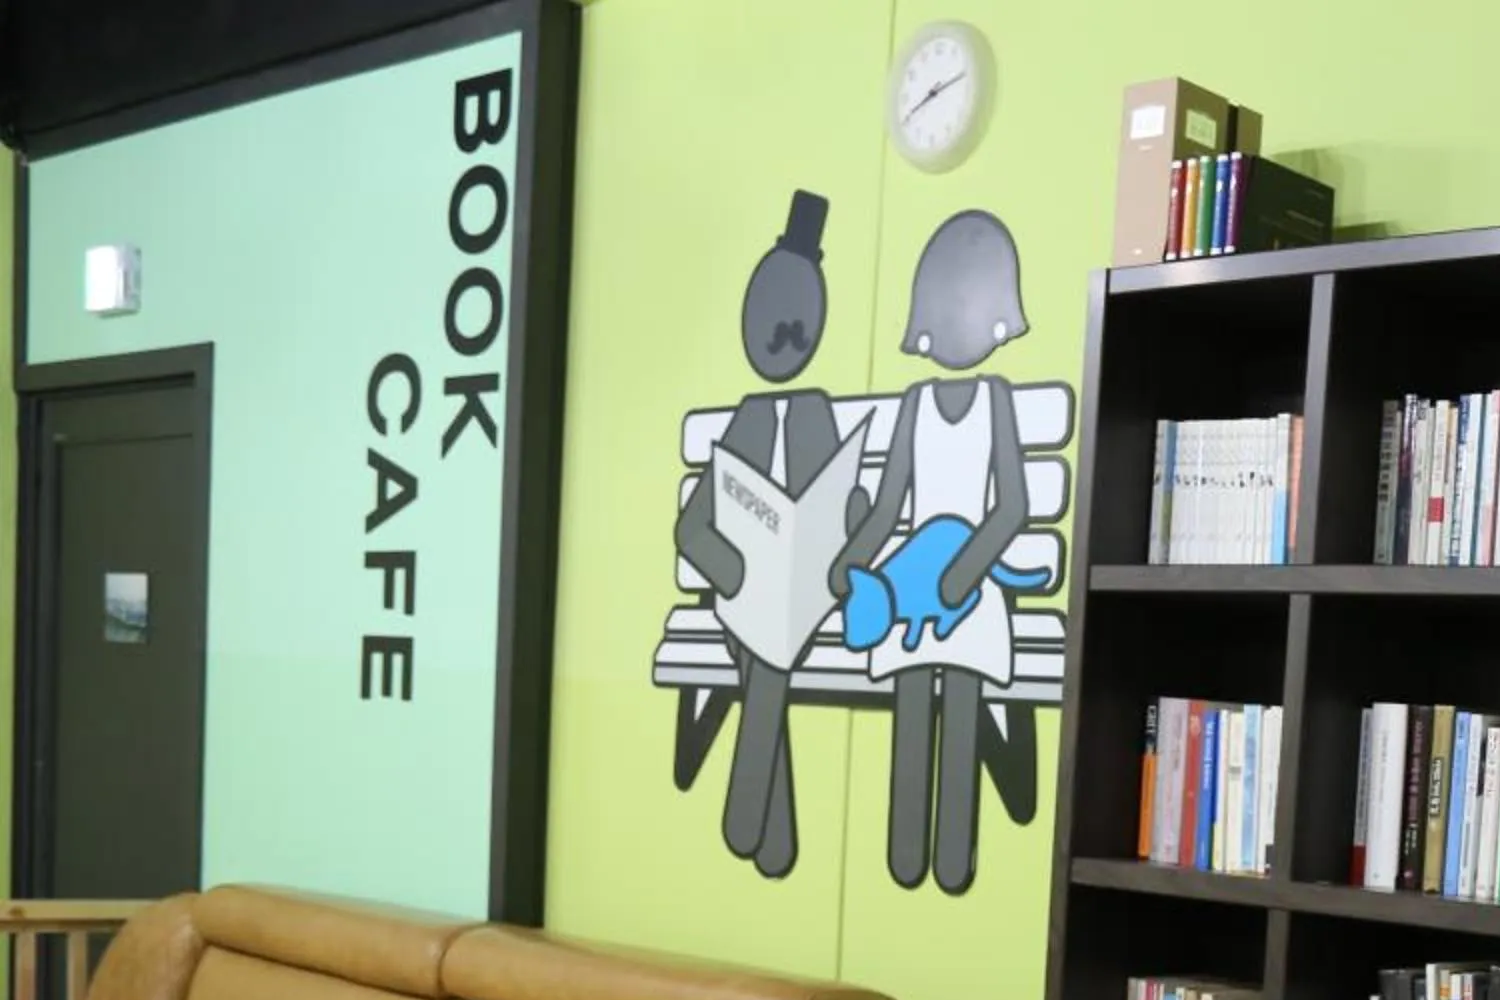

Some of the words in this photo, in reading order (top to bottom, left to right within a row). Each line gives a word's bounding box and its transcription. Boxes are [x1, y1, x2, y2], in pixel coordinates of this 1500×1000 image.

[440, 67, 513, 461] BOOK
[359, 352, 422, 702] CAFE
[721, 468, 781, 537] NEWSPAPER
